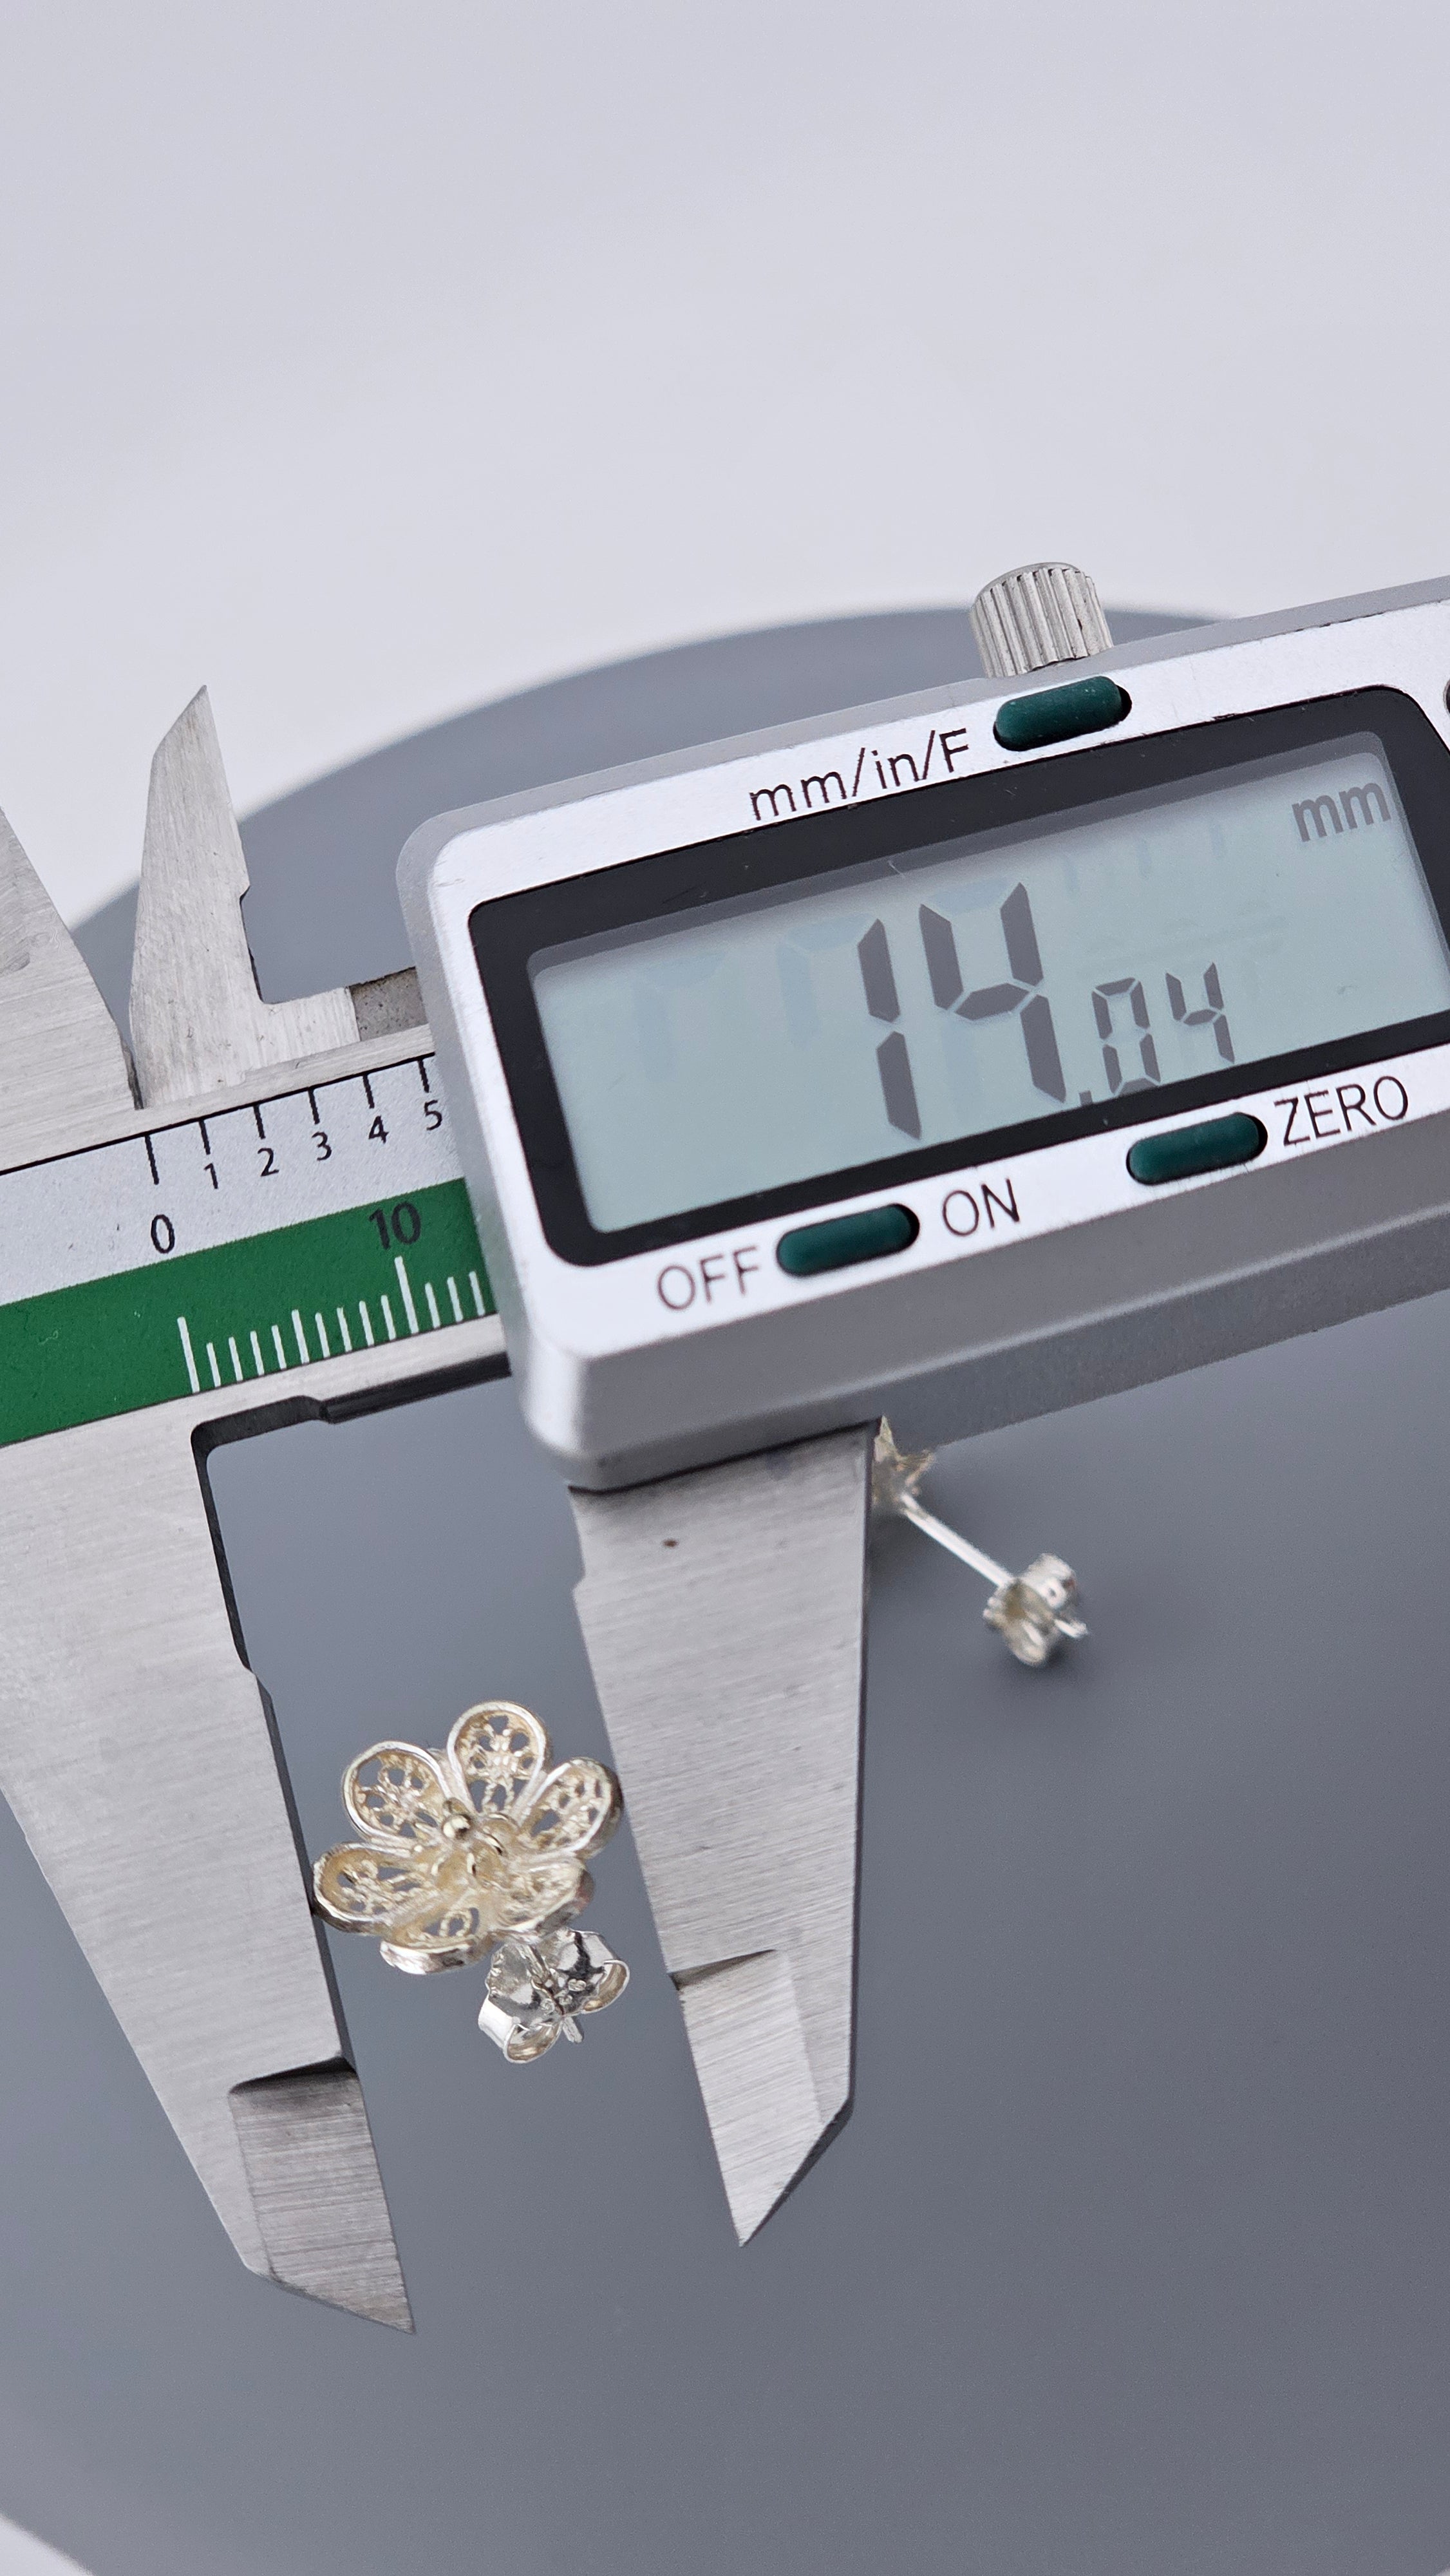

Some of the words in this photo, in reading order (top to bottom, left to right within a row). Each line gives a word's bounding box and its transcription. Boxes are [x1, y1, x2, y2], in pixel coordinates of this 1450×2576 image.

[749, 728, 969, 820] mm/in/F
[1292, 782, 1391, 842] mm
[857, 882, 1235, 1141] 14.04
[1274, 1075, 1409, 1147] ZERO
[204, 1163, 219, 1189] 1
[258, 1148, 279, 1177] 2
[312, 1132, 332, 1160] 3
[368, 1115, 389, 1144] 4
[423, 1100, 442, 1130] 5
[149, 1213, 176, 1253] 0
[368, 1202, 422, 1249] 10
[942, 1178, 1021, 1236] ON
[657, 1245, 760, 1311] OFF
